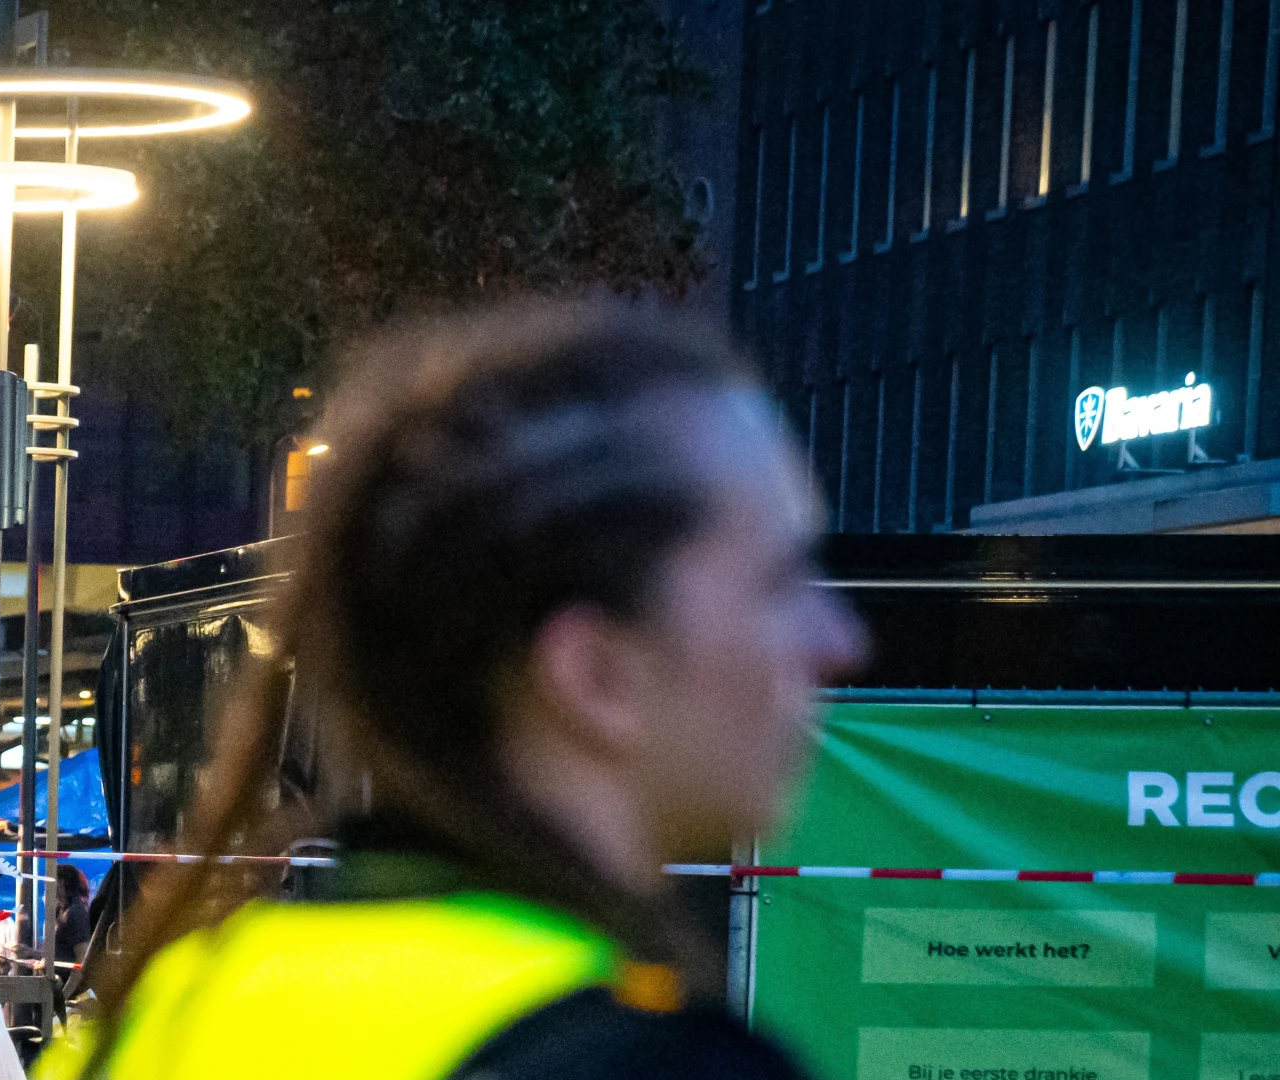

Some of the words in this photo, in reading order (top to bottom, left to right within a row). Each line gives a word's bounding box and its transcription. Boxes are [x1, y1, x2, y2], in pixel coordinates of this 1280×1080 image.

[1101, 371, 1212, 444] Bavaria
[1127, 771, 1280, 828] REC
[927, 941, 969, 957] Hoe
[974, 942, 1037, 958] werkt
[1043, 942, 1091, 959] het?
